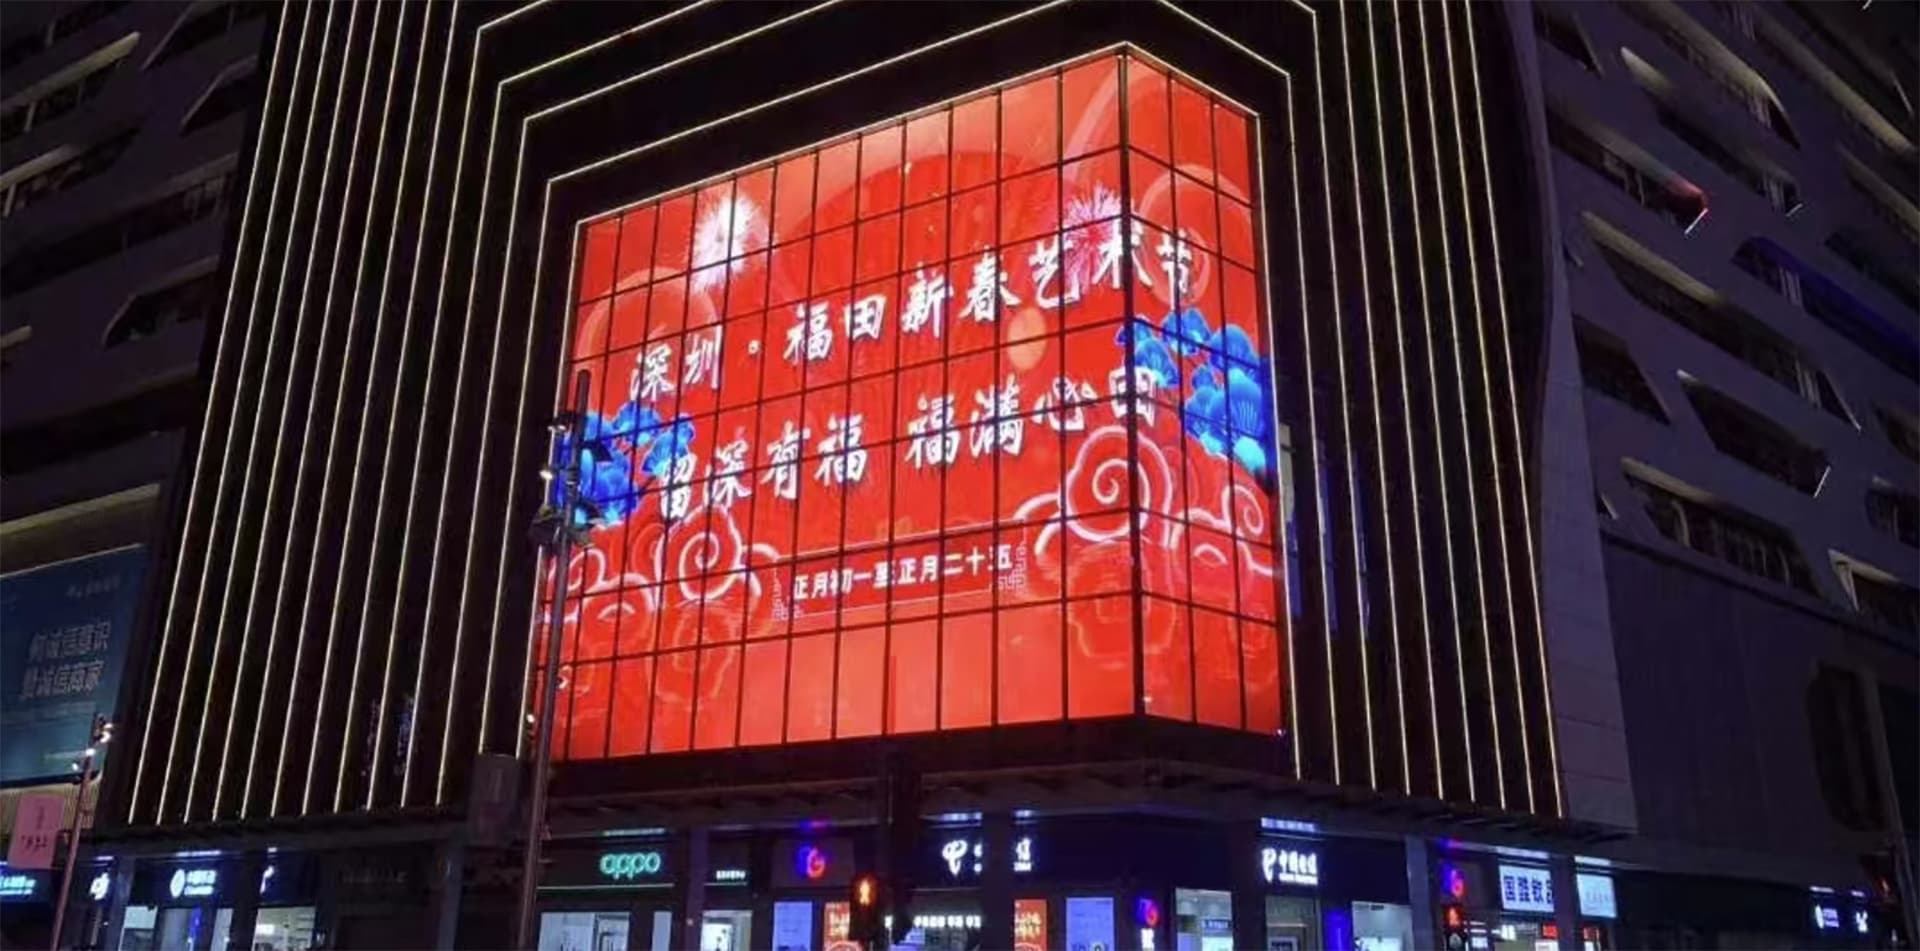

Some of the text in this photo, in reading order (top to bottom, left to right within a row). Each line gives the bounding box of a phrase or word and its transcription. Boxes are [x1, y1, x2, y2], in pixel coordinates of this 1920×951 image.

[660, 413, 868, 519] 留深有福
[793, 543, 1013, 600] 正月初一至正月二十五
